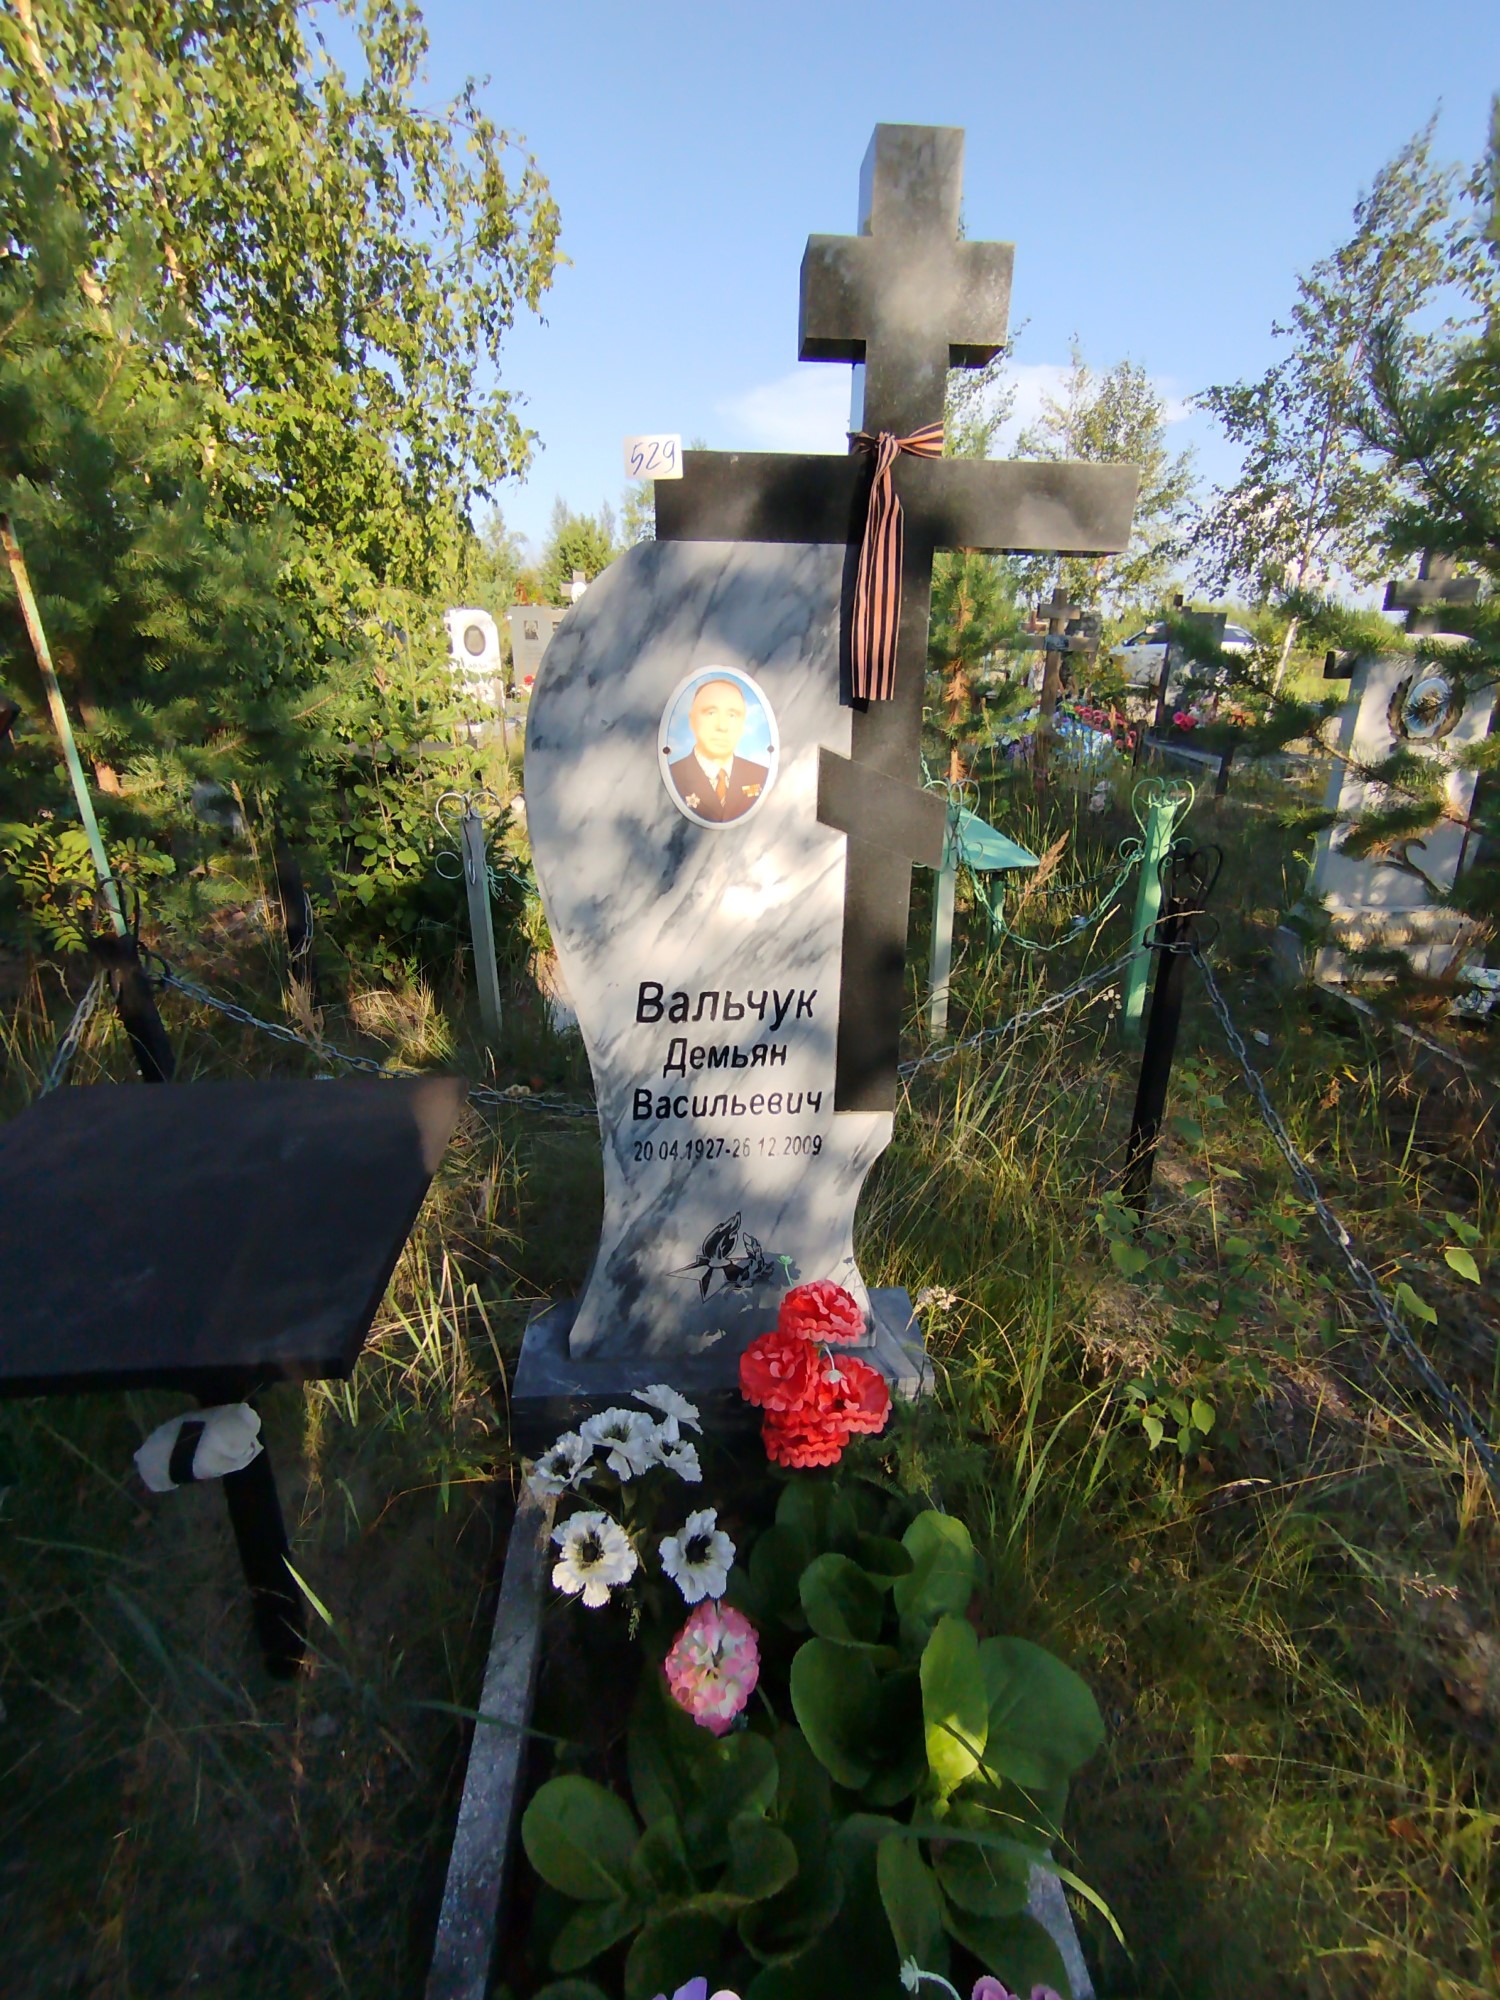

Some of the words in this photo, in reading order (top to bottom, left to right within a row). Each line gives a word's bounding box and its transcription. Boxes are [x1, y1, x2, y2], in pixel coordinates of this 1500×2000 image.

[630, 440, 675, 475] 529
[636, 981, 818, 1031] Вальчук
[662, 1037, 787, 1078] Демьян
[632, 1088, 823, 1121] Васильевич
[633, 1134, 823, 1162] 20.04.1927-2612.2009
